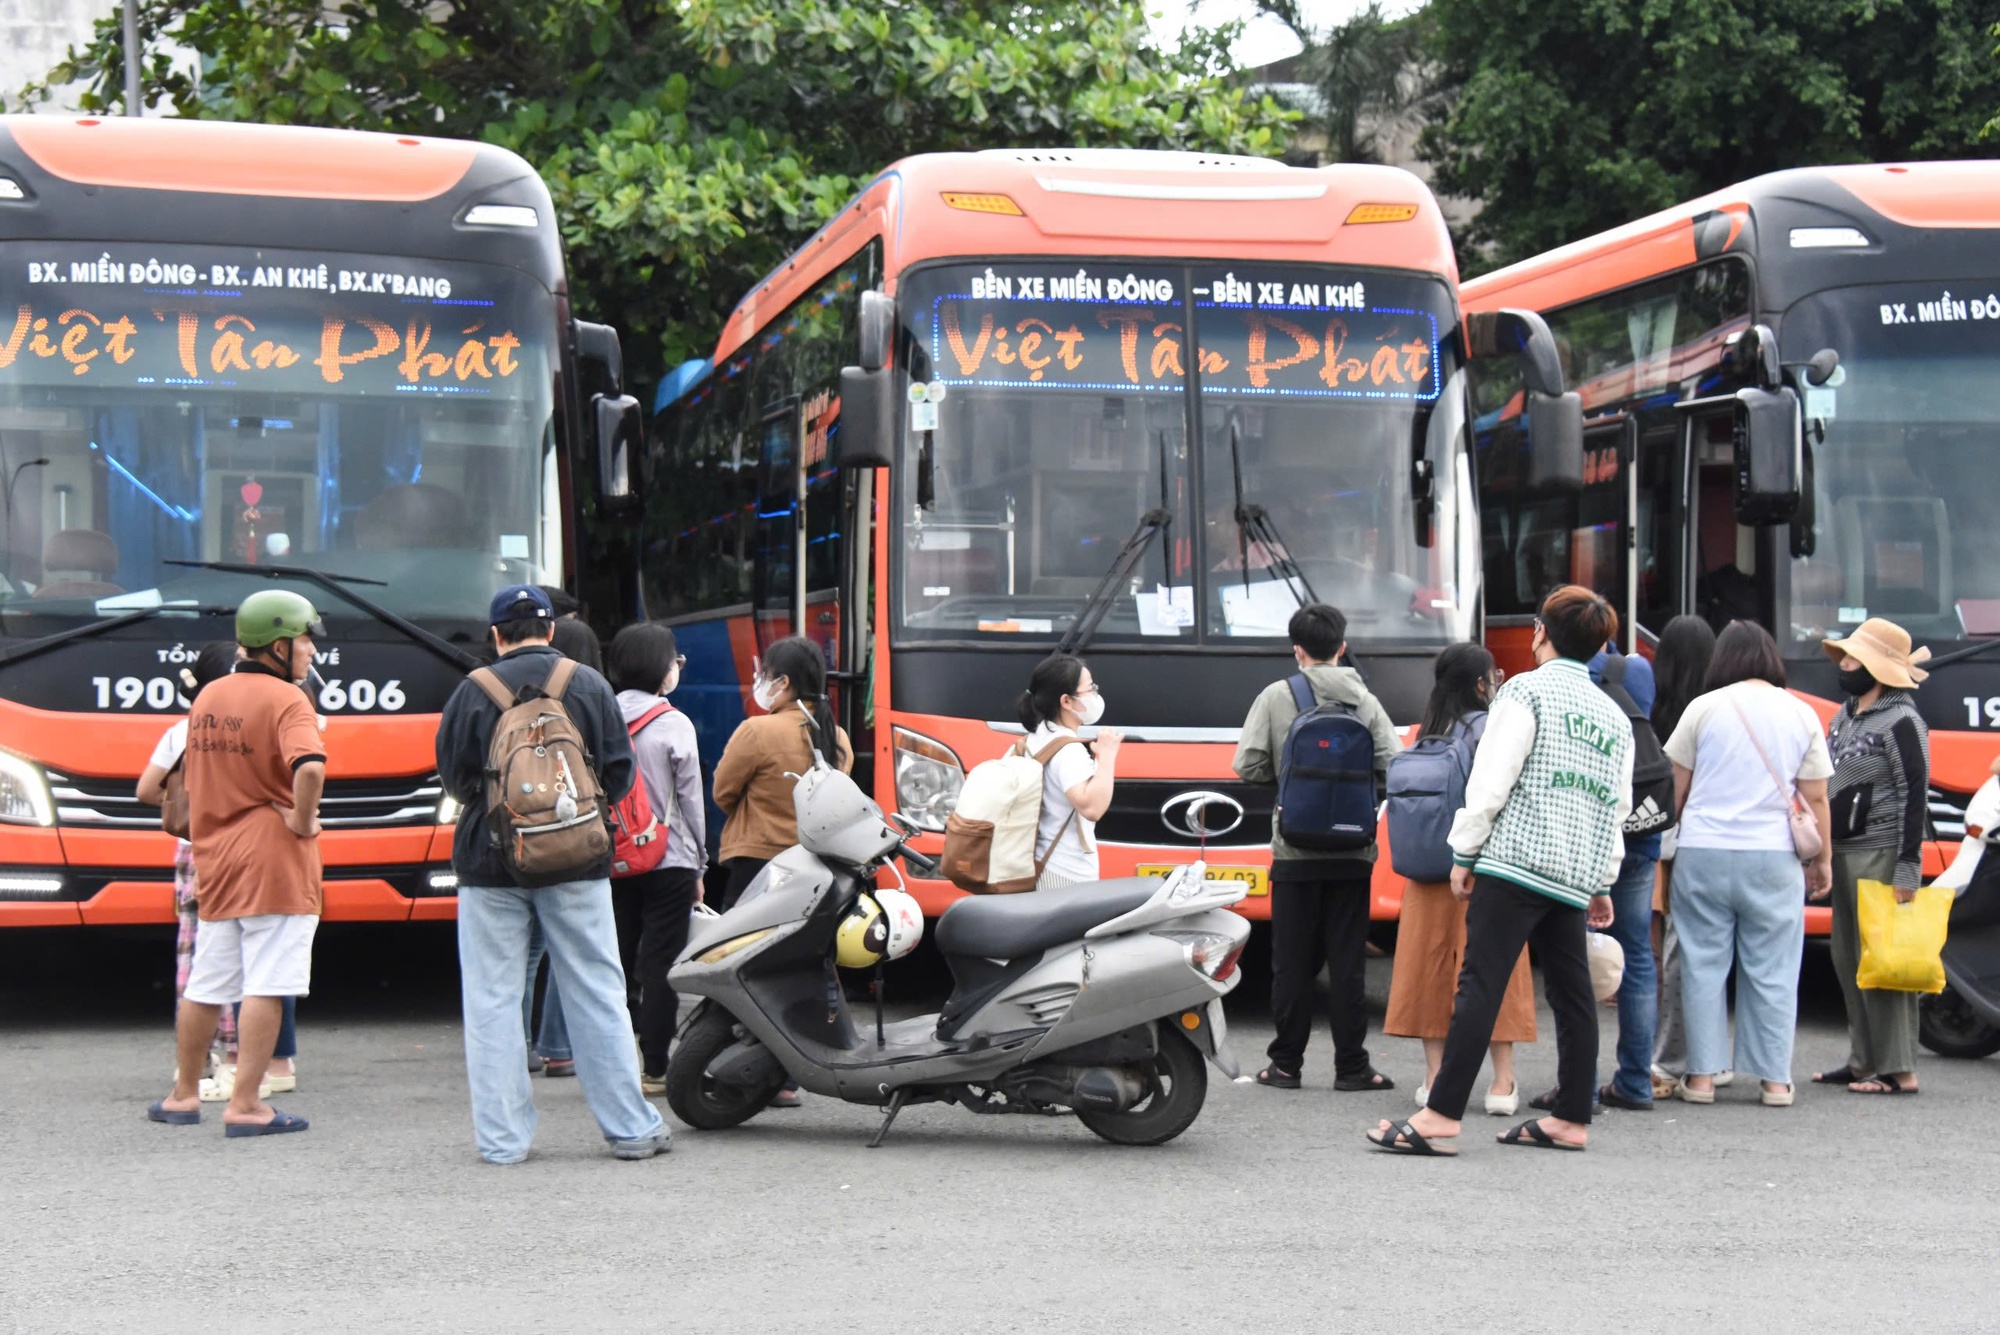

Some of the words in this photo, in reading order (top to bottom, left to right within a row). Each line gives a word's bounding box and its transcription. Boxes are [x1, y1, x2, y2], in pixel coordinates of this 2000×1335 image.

[28, 262, 67, 283] BX.
[70, 251, 125, 283] MIỀN
[129, 257, 197, 285] ĐÔNG
[211, 265, 249, 286] BX.
[252, 266, 283, 287] AN
[971, 267, 1012, 299] BẾN
[1017, 277, 1044, 299] XE
[1049, 268, 1102, 301] MIỀN
[1107, 273, 1174, 301] ĐÔNG
[1212, 272, 1252, 304] BẾN
[1257, 282, 1284, 304] XE
[1289, 284, 1319, 306] AN
[1325, 281, 1366, 308] KHÊ
[1880, 303, 1916, 325] BX.
[1917, 290, 1967, 322] MIỀN
[313, 315, 520, 383] Phát
[942, 301, 1085, 382] Việt
[1096, 307, 1229, 383] Tân
[1244, 312, 1429, 388] Phát
[314, 648, 340, 665] VÉ
[319, 679, 406, 711] 606
[1566, 712, 1611, 752] GOAT
[1622, 811, 1668, 833] adidas
